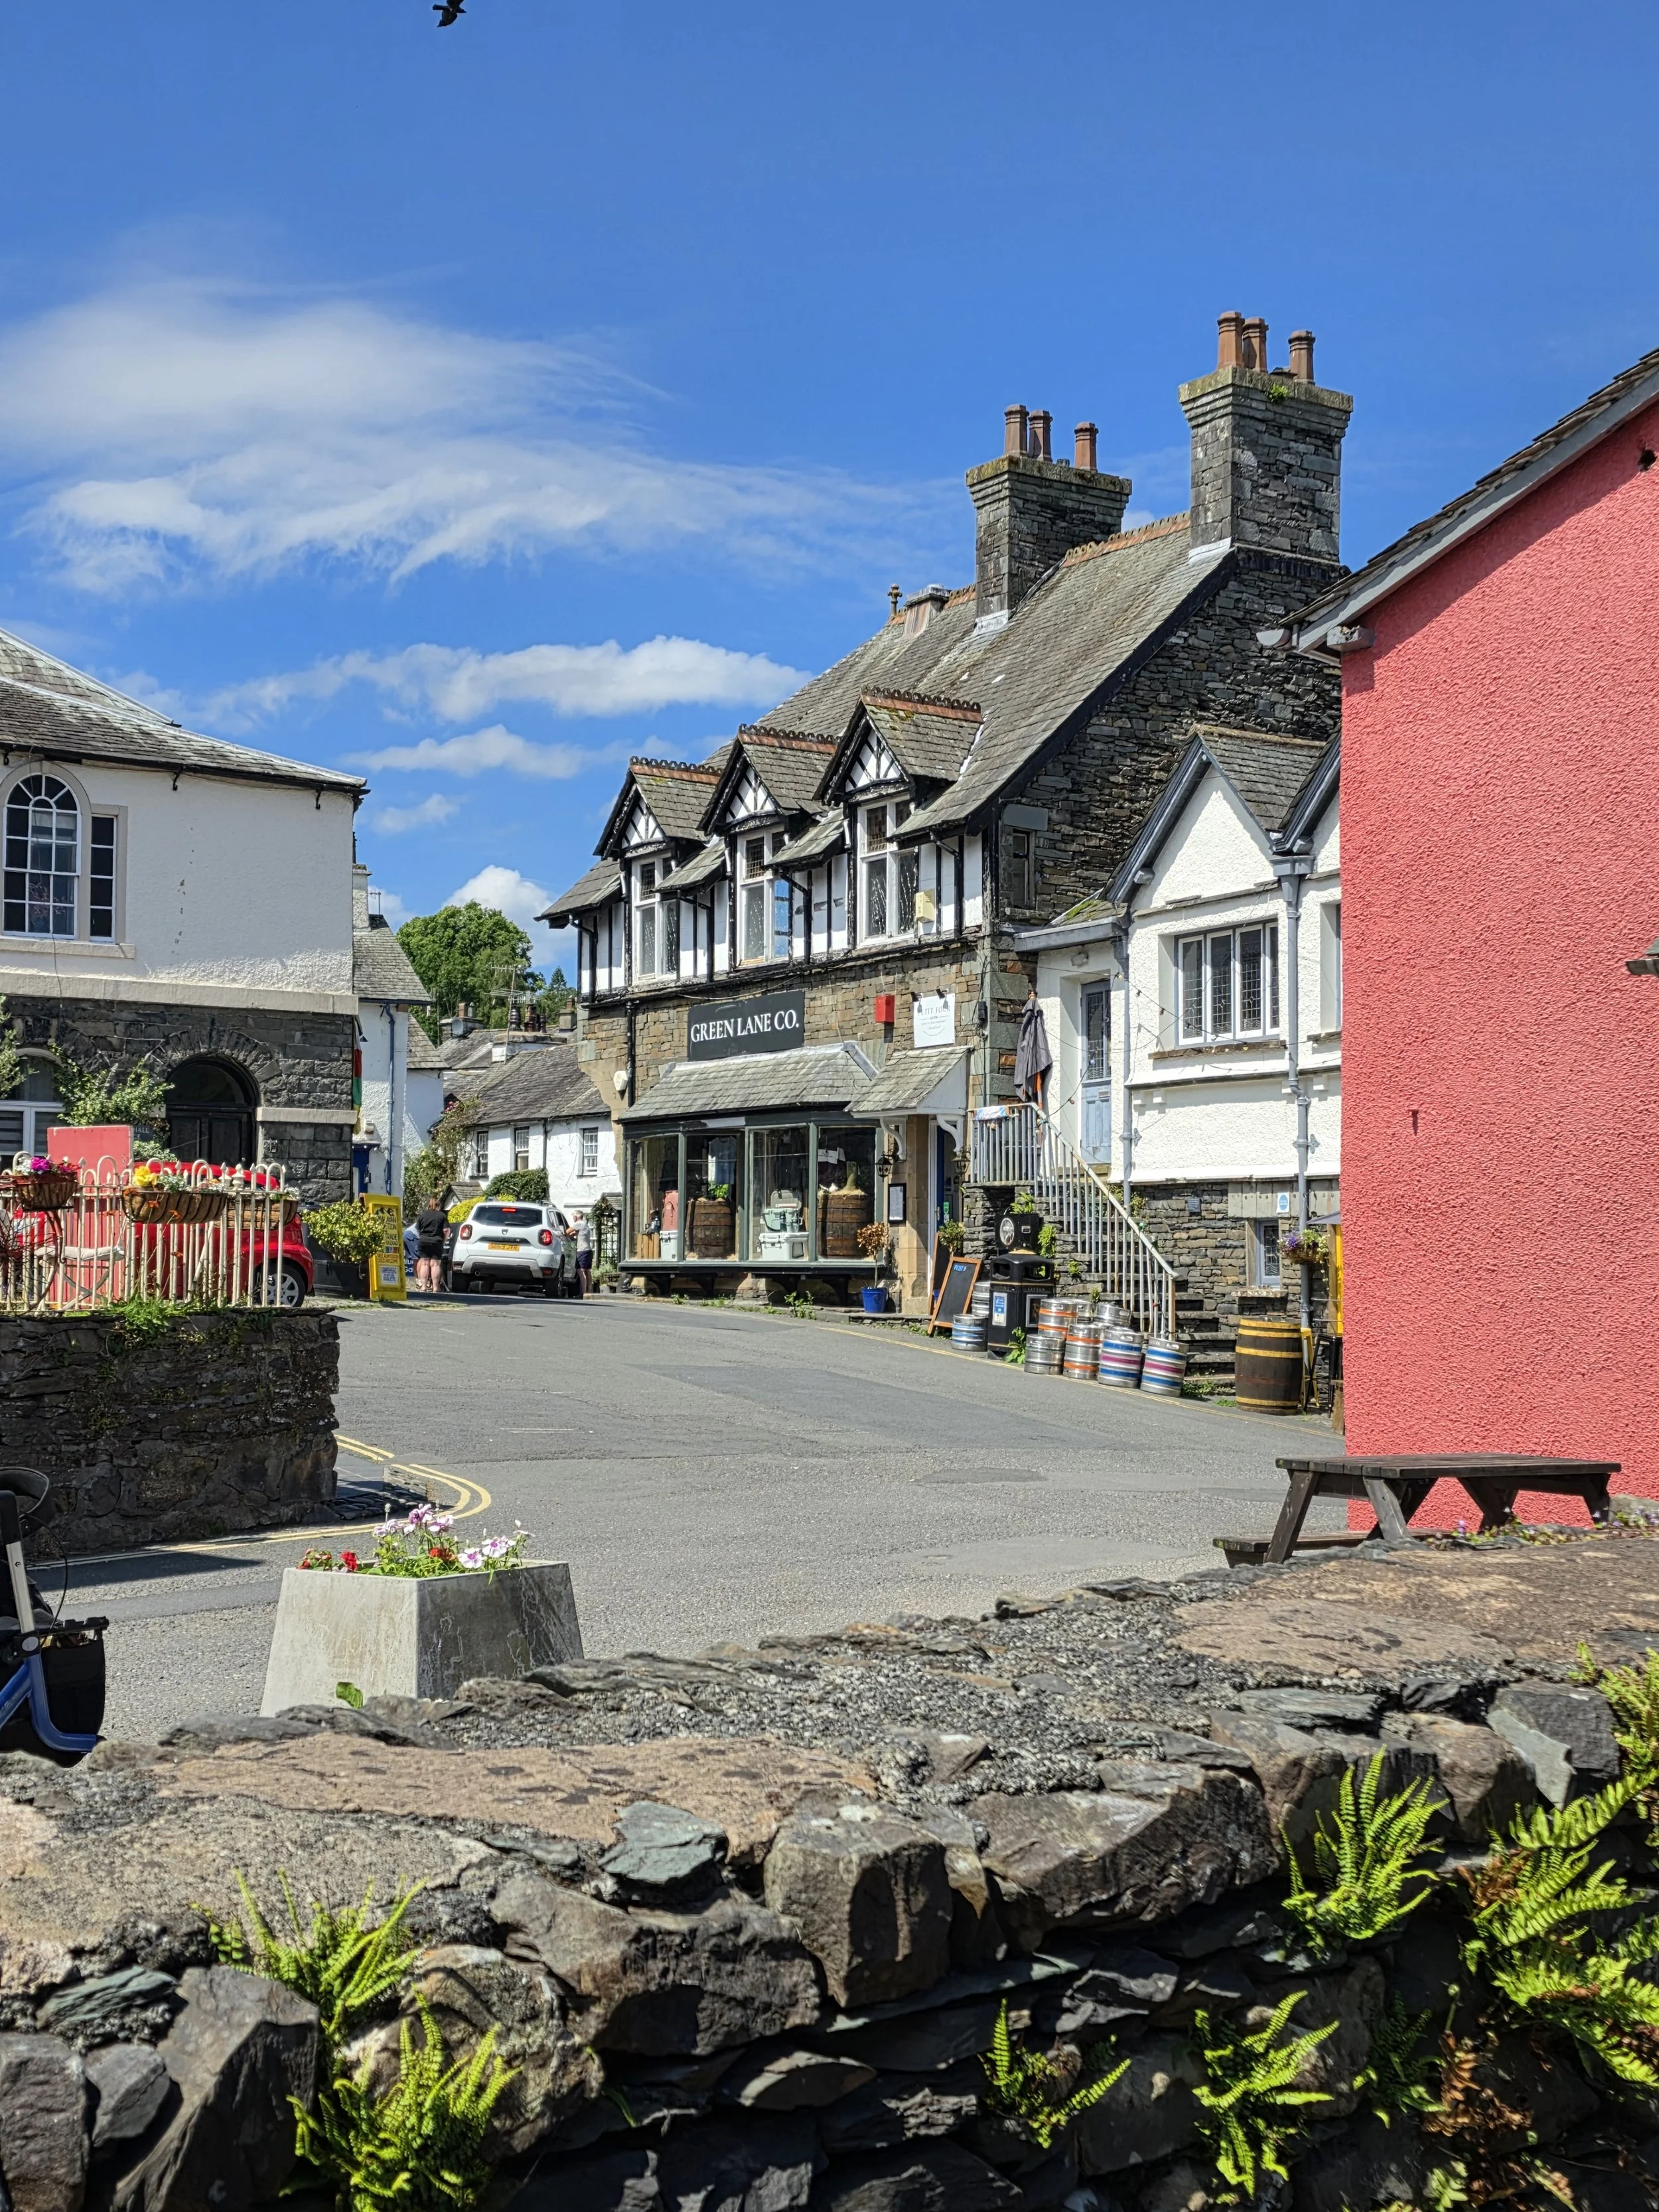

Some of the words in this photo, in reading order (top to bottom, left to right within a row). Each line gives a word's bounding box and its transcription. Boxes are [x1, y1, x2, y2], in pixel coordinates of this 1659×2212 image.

[691, 1019, 734, 1042] GREEN
[737, 1013, 771, 1036] LANE
[774, 1009, 800, 1030] CO.
